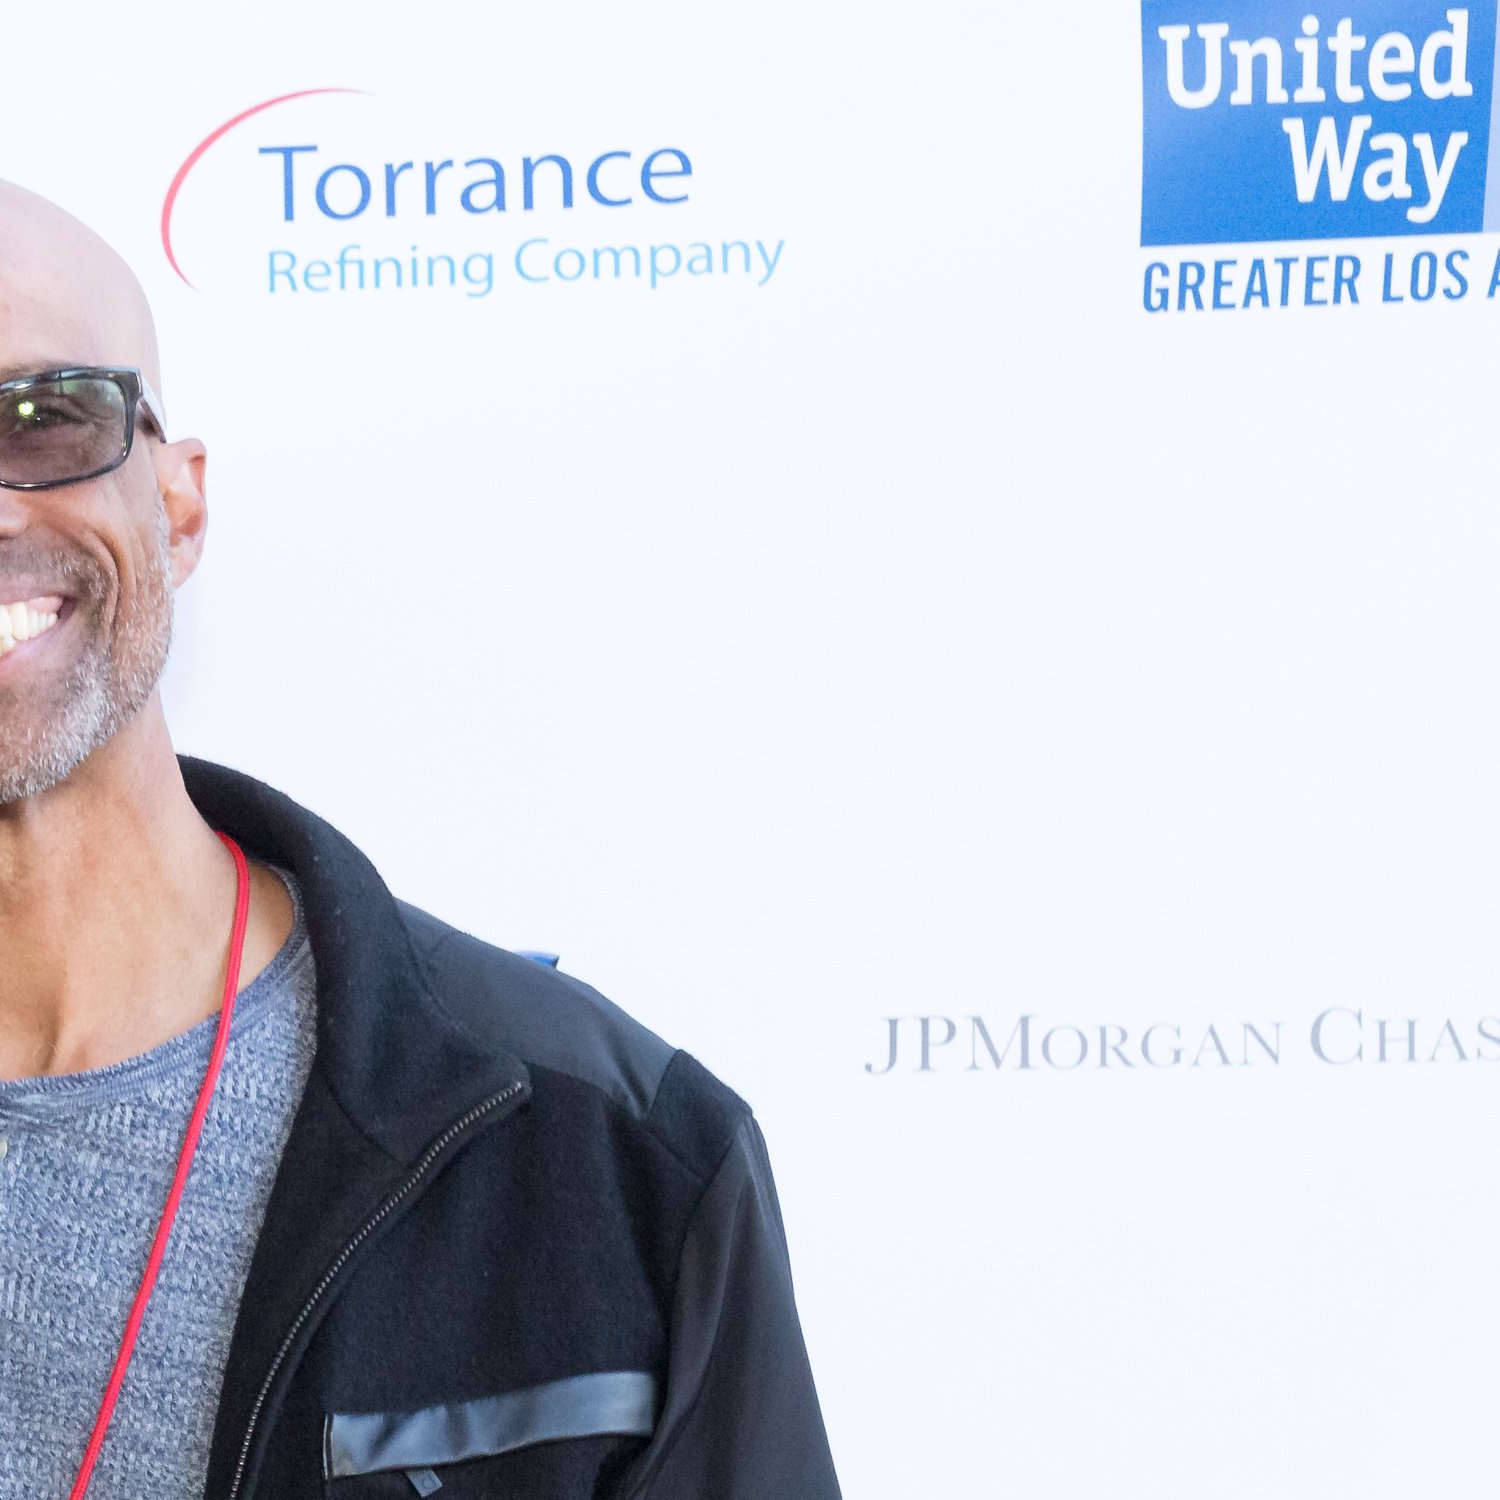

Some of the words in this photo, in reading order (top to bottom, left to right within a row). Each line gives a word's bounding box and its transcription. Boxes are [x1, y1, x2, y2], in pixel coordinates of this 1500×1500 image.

[1158, 8, 1473, 109] United
[258, 143, 694, 223] Torrance
[1281, 114, 1469, 224] Way
[266, 244, 495, 299] Refining
[514, 237, 785, 289] Company
[1142, 254, 1362, 313] GREATER
[1382, 249, 1470, 303] LOS
